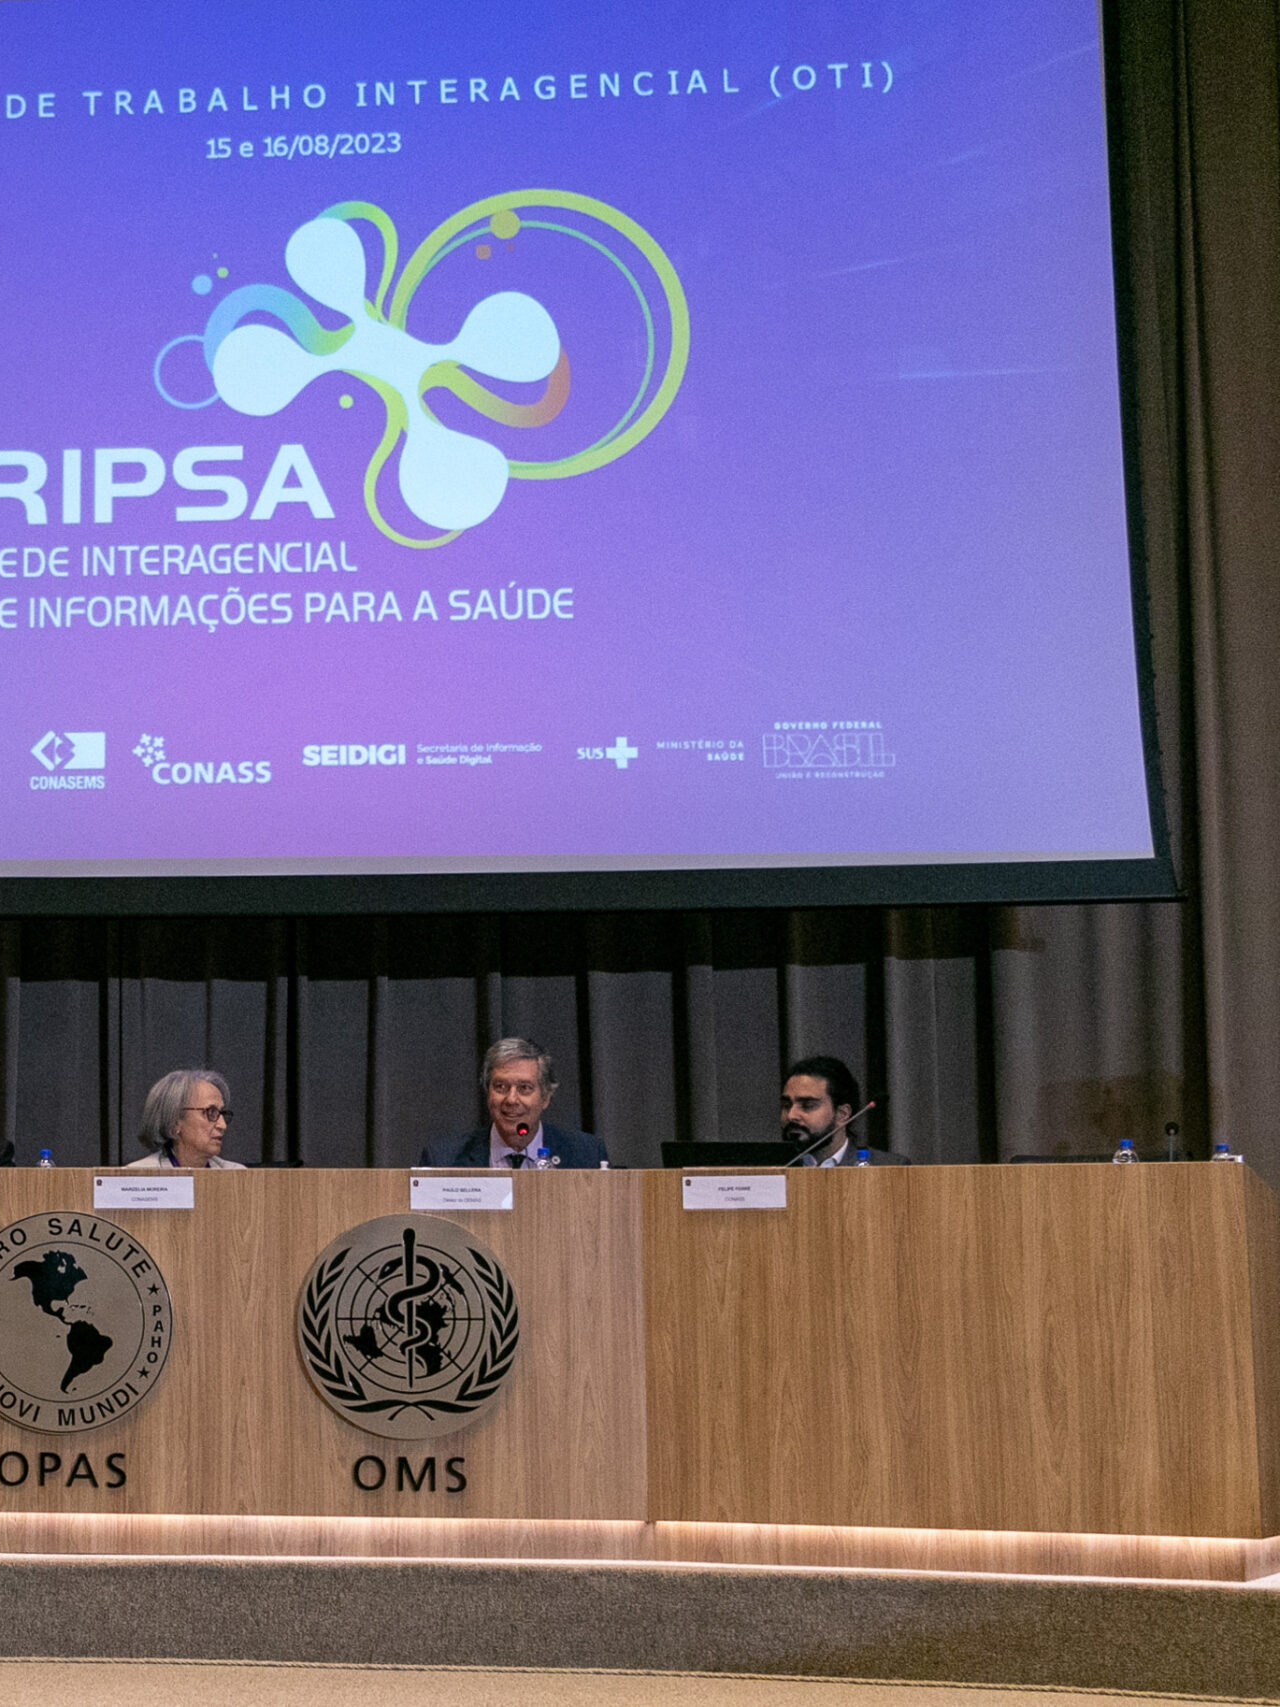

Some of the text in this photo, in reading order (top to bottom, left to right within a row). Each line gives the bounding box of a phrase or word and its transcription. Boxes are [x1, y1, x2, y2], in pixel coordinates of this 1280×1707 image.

[5, 93, 56, 119] DE
[82, 84, 326, 117] TRABALHO
[355, 69, 739, 107] INTERAGENCIAL
[769, 61, 895, 98] (OTI)
[206, 132, 402, 160] 15 e 16/08/2023
[82, 541, 358, 577] INTERAGENCIAL
[28, 586, 294, 633] INFORMAÇÕES
[305, 590, 402, 625] PARA
[412, 589, 439, 622] A
[448, 581, 575, 622] SAÚDE
[302, 743, 407, 767] SEIDIGI
[470, 743, 484, 754] de
[576, 746, 605, 760] SUS
[729, 740, 744, 750] DA
[29, 774, 106, 791] CONASEMS
[151, 760, 273, 785] CONASS
[47, 1217, 152, 1279] SALUTE
[146, 1304, 165, 1364] PAHO
[57, 1381, 140, 1427] MUNDI
[352, 1454, 468, 1493] OMS
